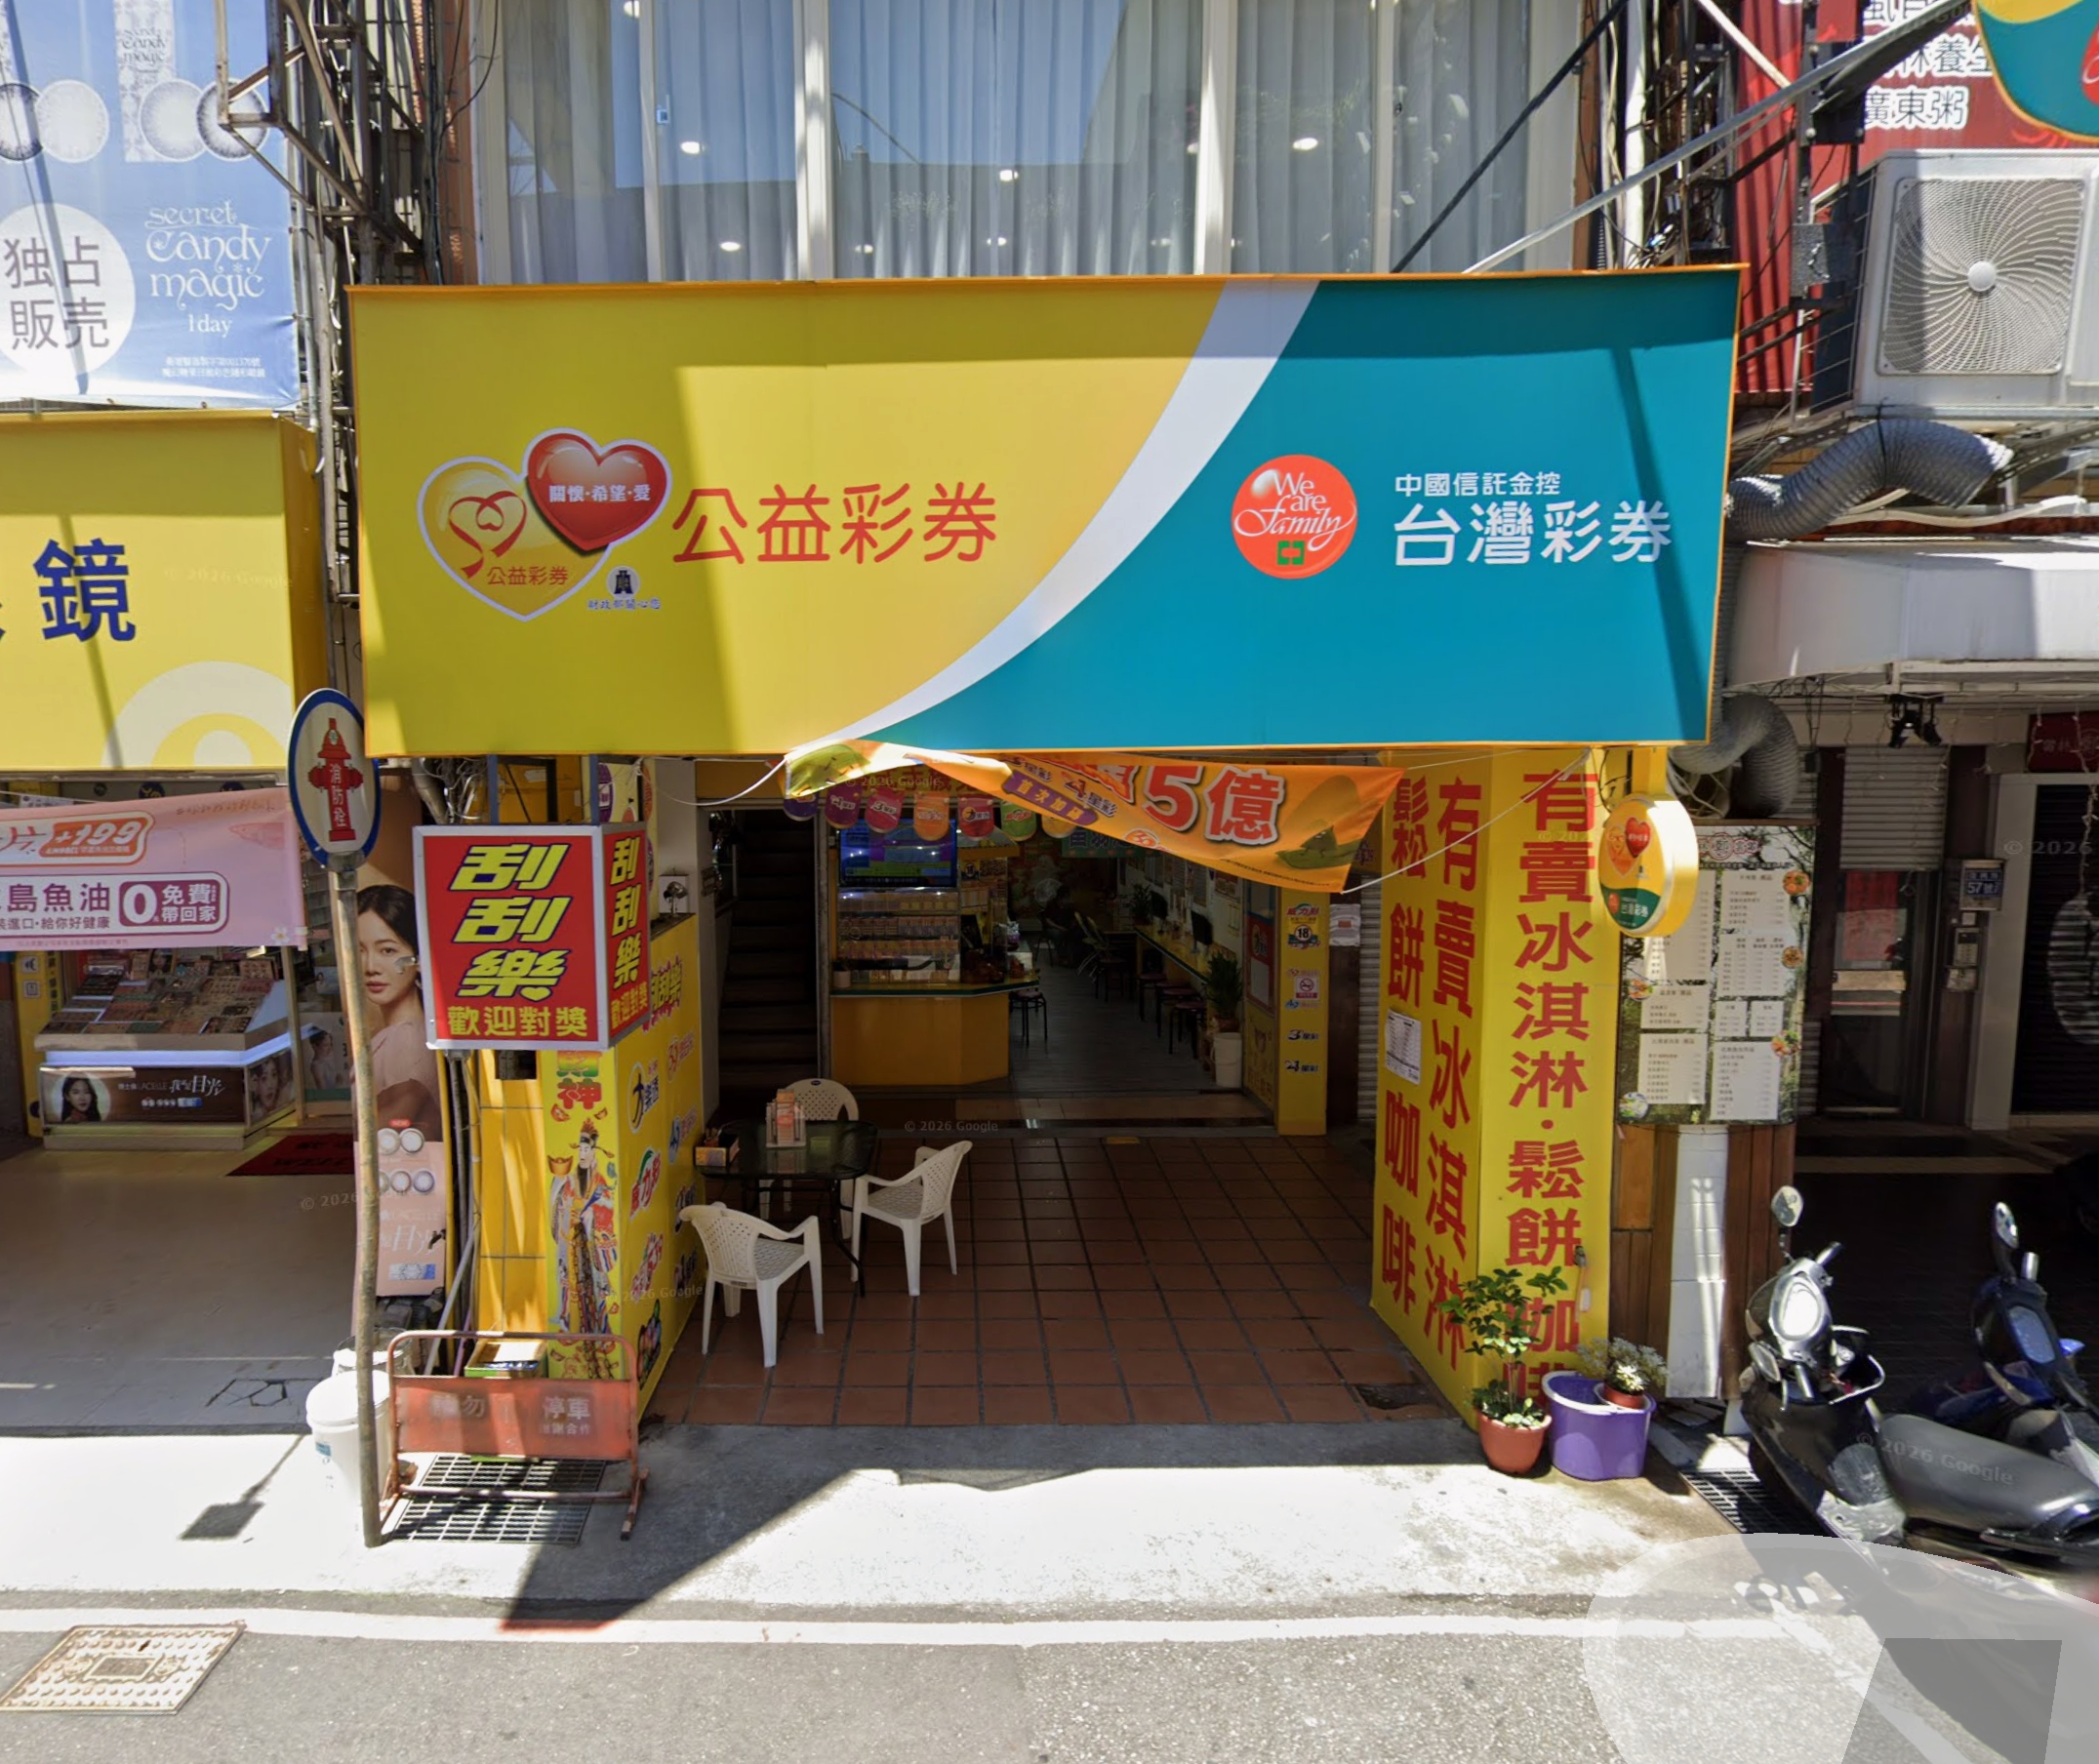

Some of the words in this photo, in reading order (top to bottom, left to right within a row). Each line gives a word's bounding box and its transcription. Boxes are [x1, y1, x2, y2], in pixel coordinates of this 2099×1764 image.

[4, 235, 102, 290] 独占
[144, 224, 273, 276] Candy
[149, 262, 266, 311] magic
[11, 297, 109, 351] 販売
[1273, 470, 1315, 497] We
[1289, 494, 1327, 513] are
[1394, 471, 1561, 498] 中國信託金控
[671, 480, 997, 565] 公益彩券
[1393, 499, 1673, 567] 台灣彩券
[0, 537, 136, 643] 鏡
[487, 566, 569, 587] 公益彩券
[55, 822, 142, 846] +199
[0, 882, 111, 913] 島魚油
[122, 883, 156, 924] 0
[161, 906, 217, 923] 帶回家
[162, 883, 211, 905] 免費
[610, 836, 642, 991] 刮刮樂
[448, 843, 573, 1002] 刮刮樂
[1298, 927, 1311, 939] 18
[447, 1005, 588, 1037] 歡迎對獎
[1381, 775, 1430, 1315] 鬆餅咖啡
[1423, 777, 1483, 1372] 有賣冰淇淋
[542, 1395, 590, 1421] 停車
